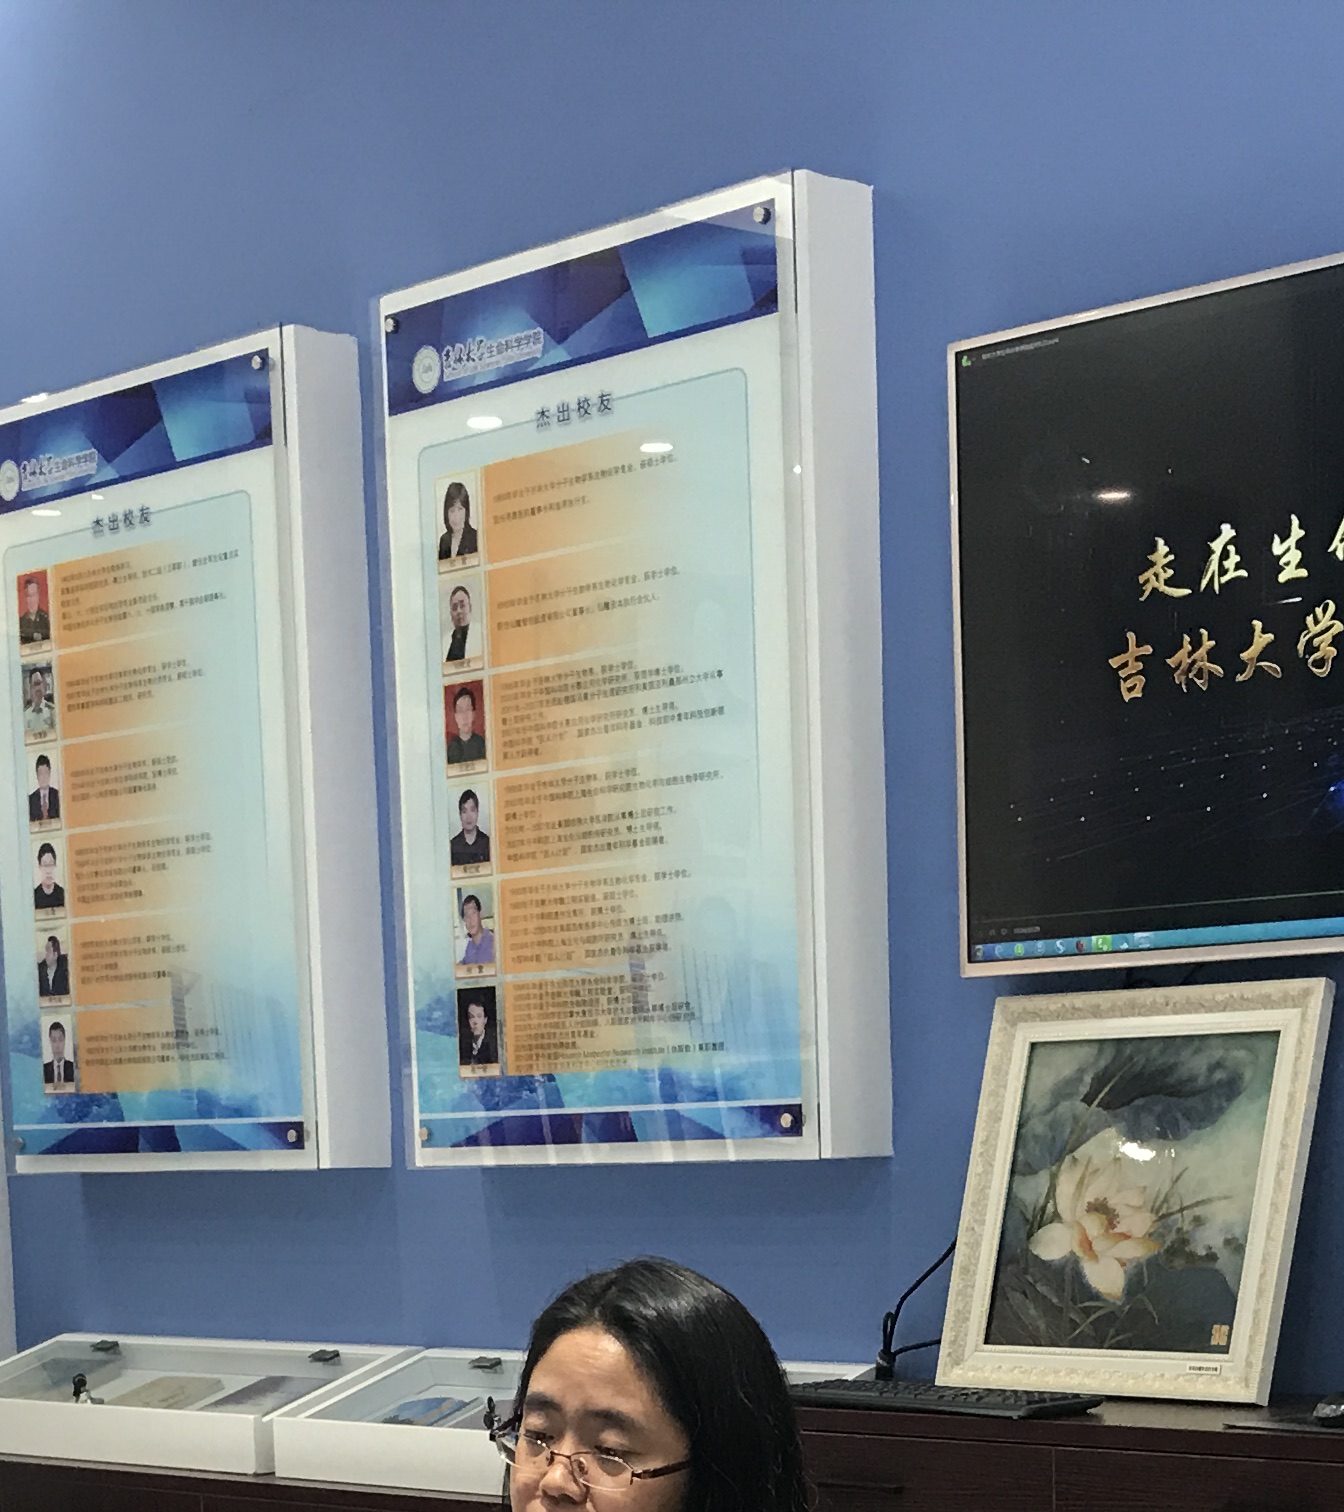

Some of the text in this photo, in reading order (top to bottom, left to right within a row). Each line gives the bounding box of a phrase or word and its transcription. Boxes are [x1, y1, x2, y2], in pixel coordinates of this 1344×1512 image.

[536, 391, 613, 429] 杰出校友
[91, 504, 153, 536] 杰出校友
